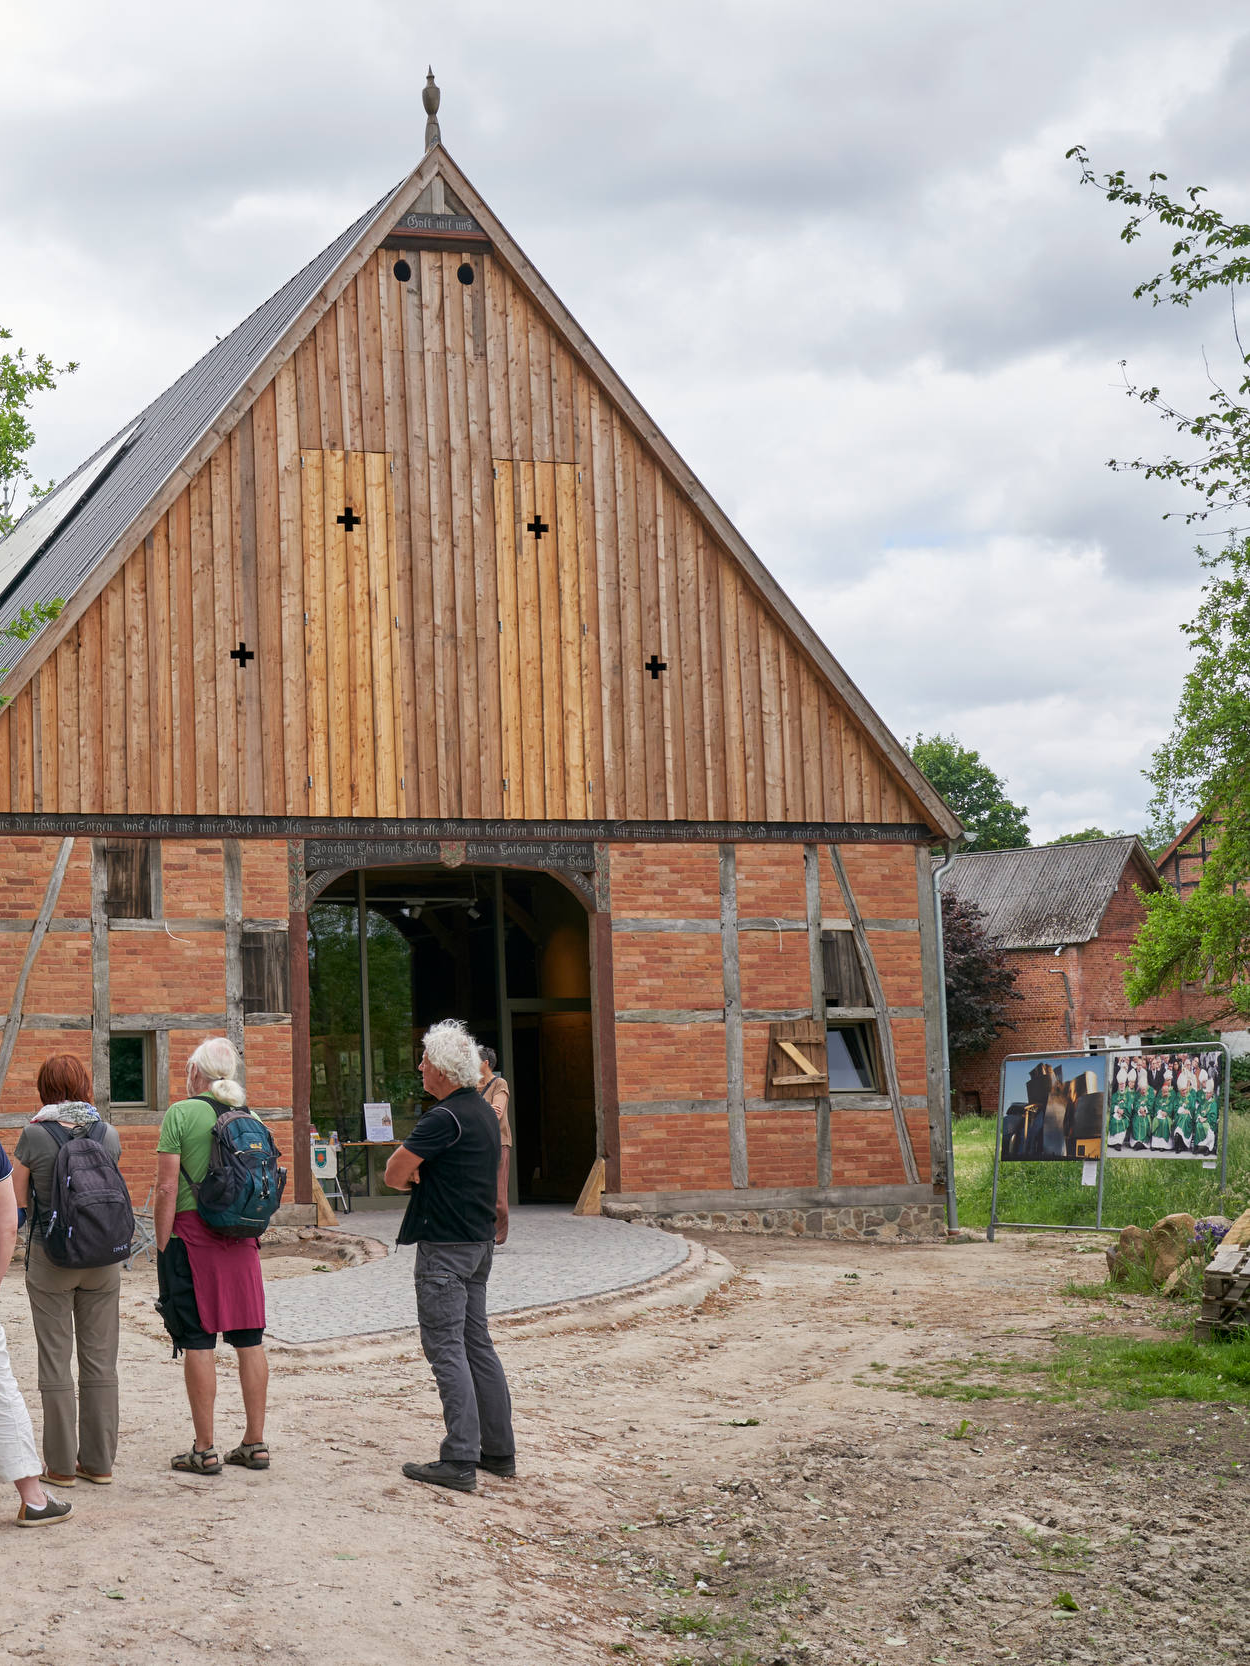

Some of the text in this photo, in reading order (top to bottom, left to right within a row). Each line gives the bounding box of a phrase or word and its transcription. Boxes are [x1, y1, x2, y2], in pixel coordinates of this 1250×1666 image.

[310, 841, 355, 856] Joachim
[358, 842, 400, 858] Christoph
[403, 842, 438, 857] Schulz
[467, 843, 495, 857] Anna
